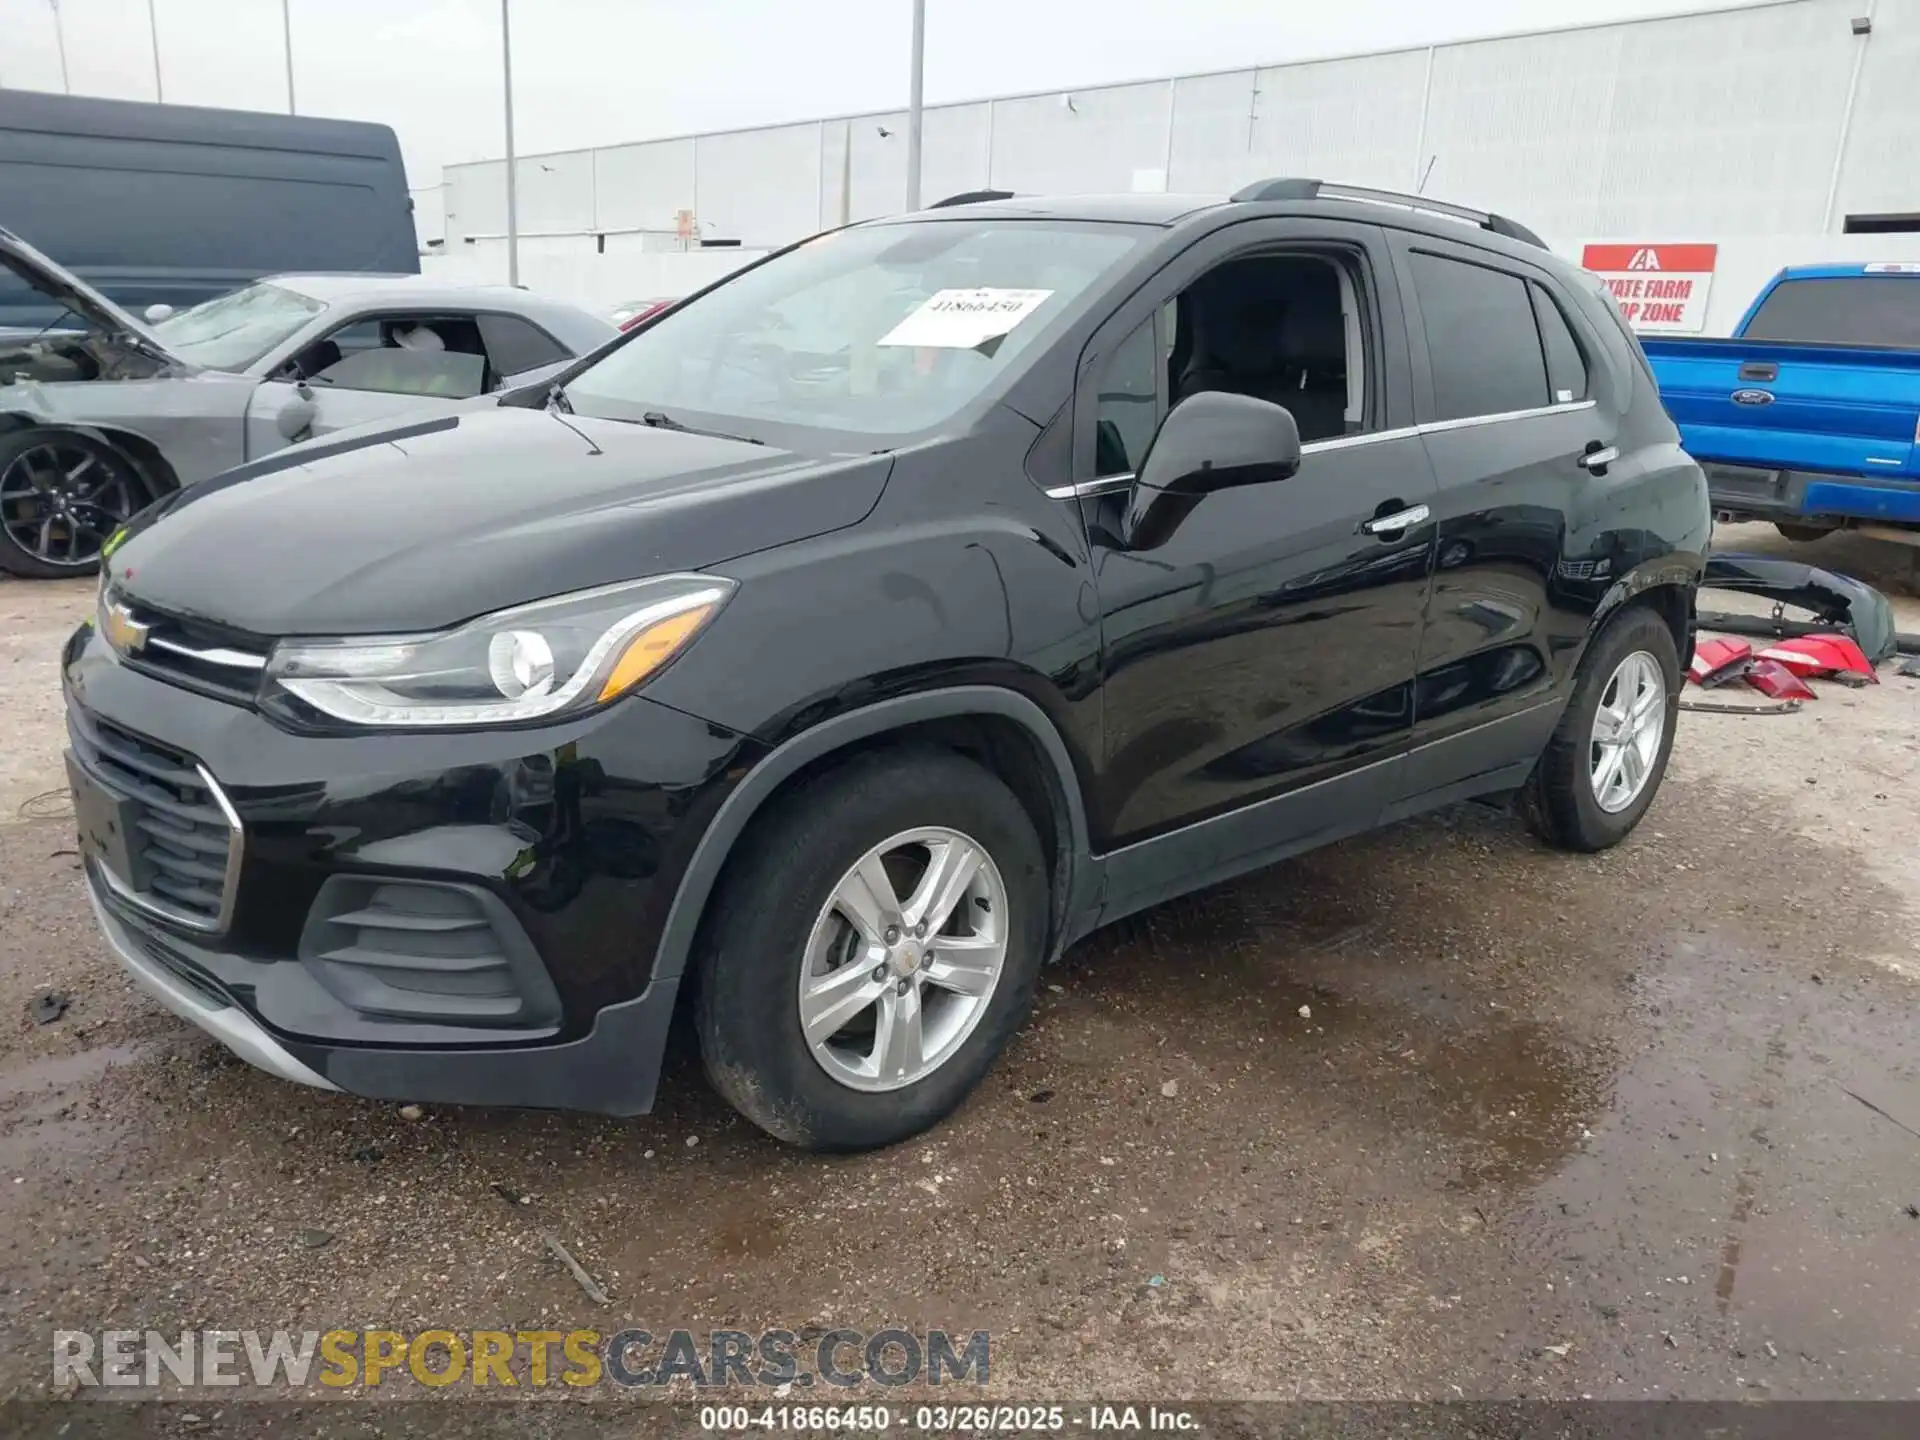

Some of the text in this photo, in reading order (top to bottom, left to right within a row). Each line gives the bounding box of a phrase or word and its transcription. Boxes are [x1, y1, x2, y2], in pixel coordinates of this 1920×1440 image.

[1601, 279, 1693, 299] TATE FARM
[1640, 303, 1685, 322] ZONE
